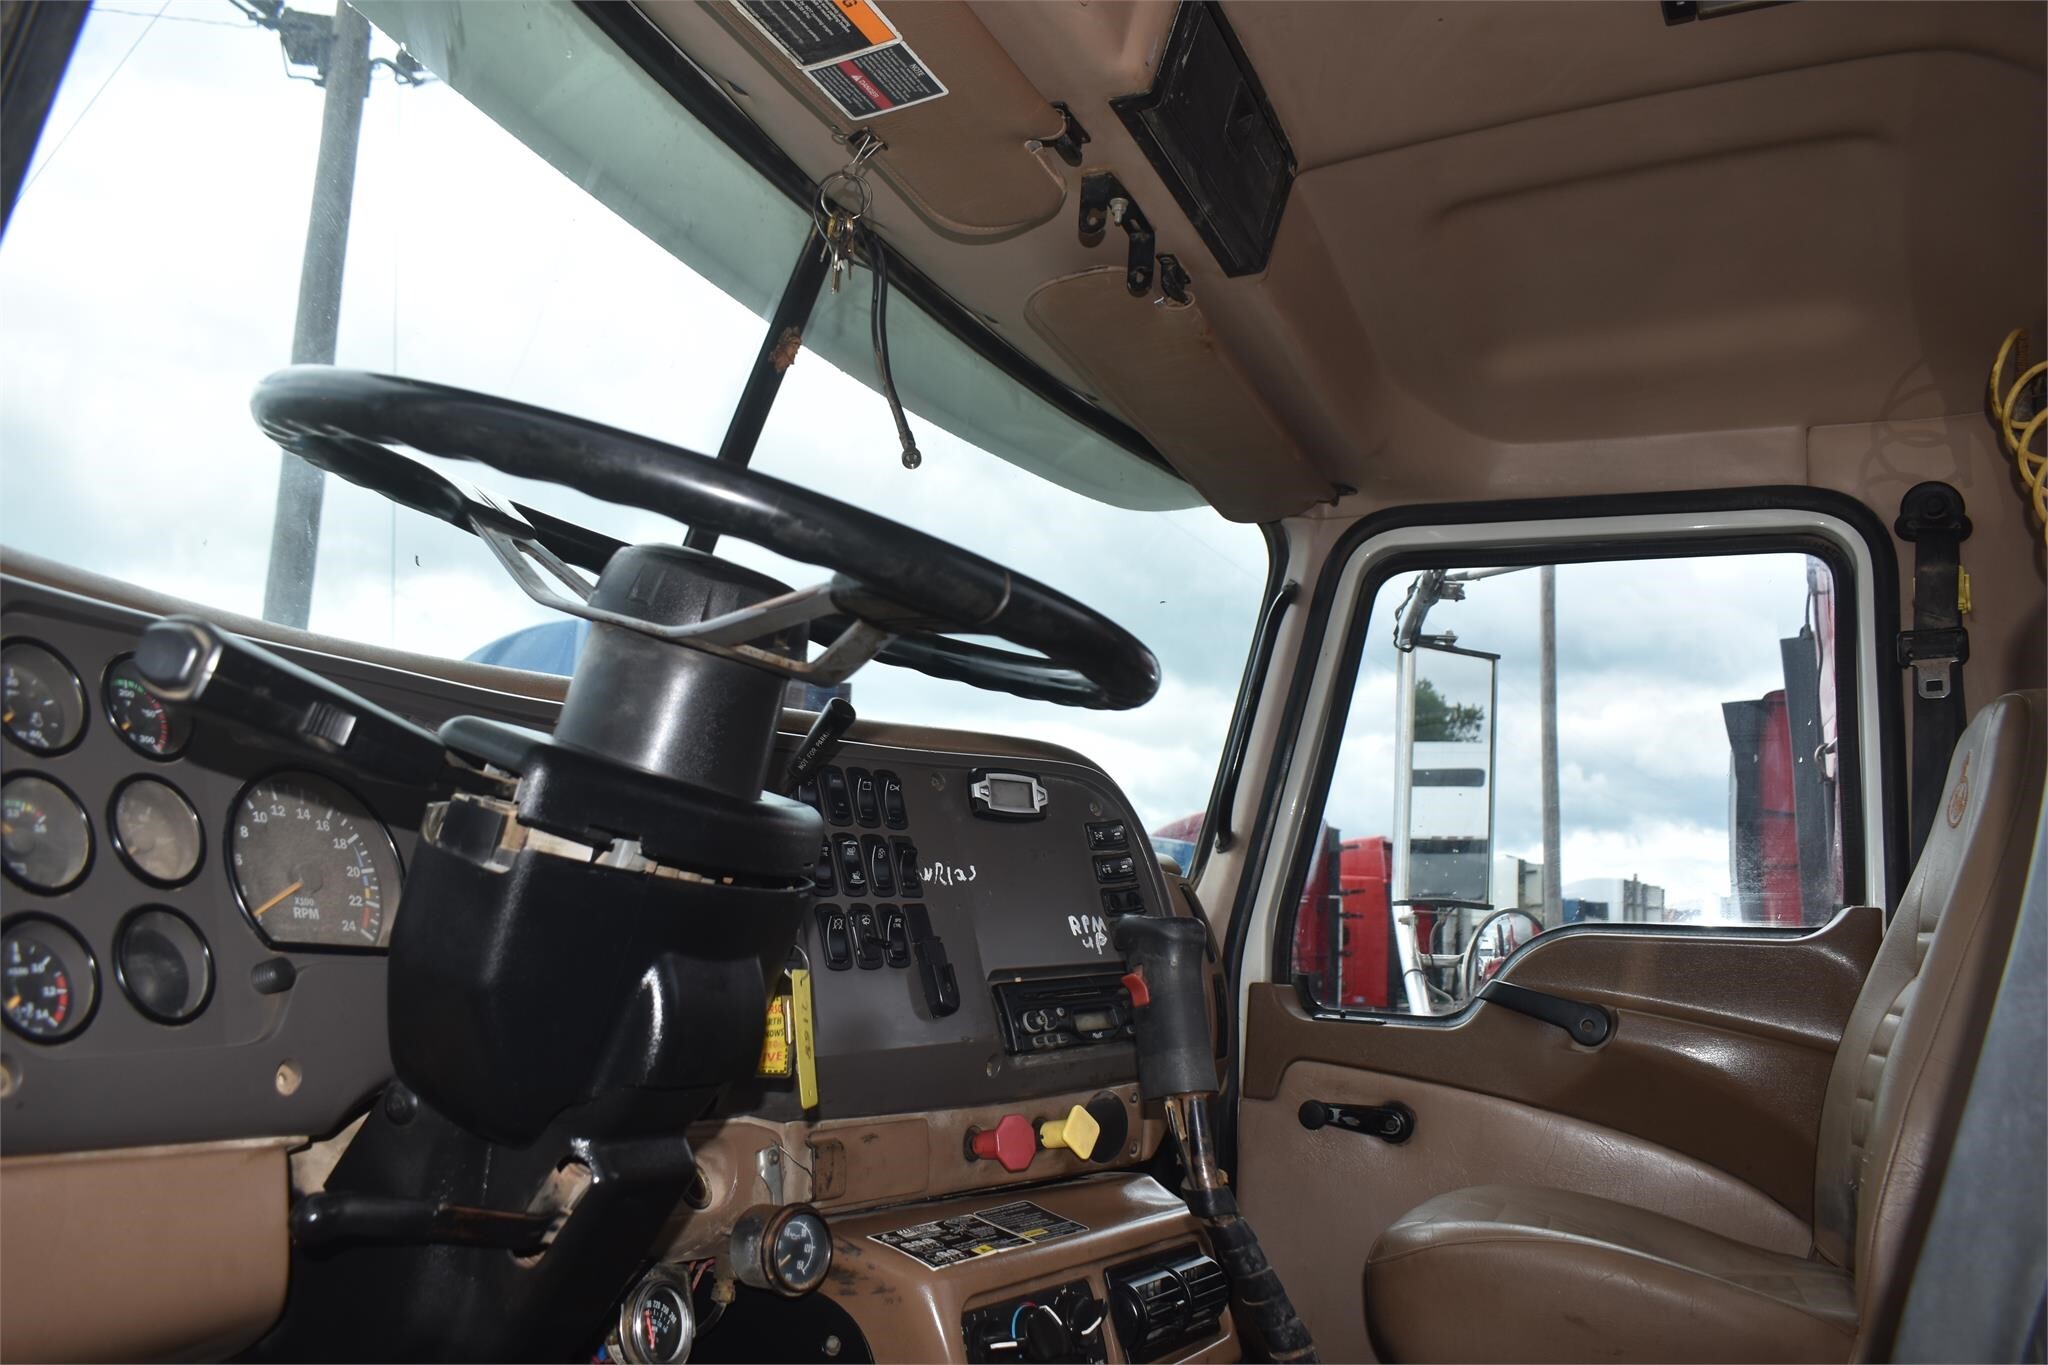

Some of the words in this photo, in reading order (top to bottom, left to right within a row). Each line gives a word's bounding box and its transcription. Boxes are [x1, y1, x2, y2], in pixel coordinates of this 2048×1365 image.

[859, 80, 879, 98] DANGER
[269, 804, 286, 817] 12
[296, 808, 311, 821] 14
[253, 811, 268, 824] 10
[240, 825, 249, 838] 8
[316, 819, 330, 832] 16
[333, 837, 348, 849] 18
[347, 865, 361, 878] 20
[349, 895, 363, 907] 22
[293, 907, 320, 920] RPM
[342, 919, 356, 932] 24
[1068, 914, 1107, 936] RPM
